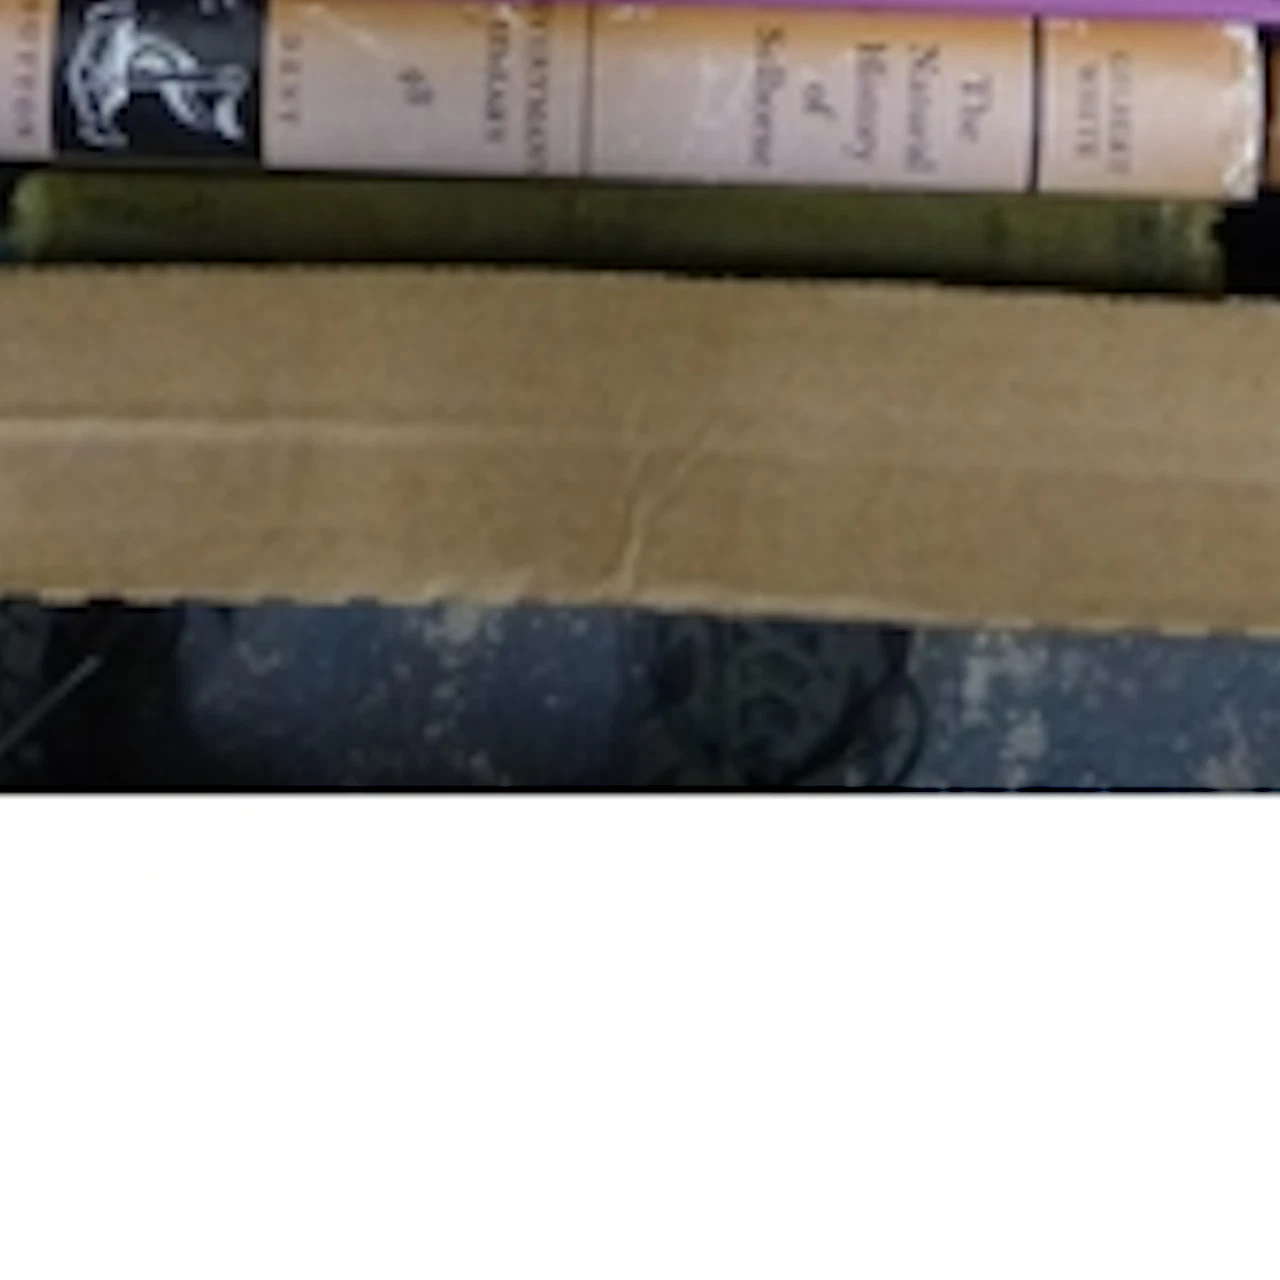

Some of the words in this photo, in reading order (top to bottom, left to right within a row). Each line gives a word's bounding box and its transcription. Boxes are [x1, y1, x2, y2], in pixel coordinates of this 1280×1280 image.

[800, 81, 836, 122] of
[846, 42, 889, 165] History
[903, 43, 939, 173] Natural
[955, 75, 991, 142] The
[1074, 62, 1099, 162] WHITE
[1104, 50, 1133, 177] GILBERT
